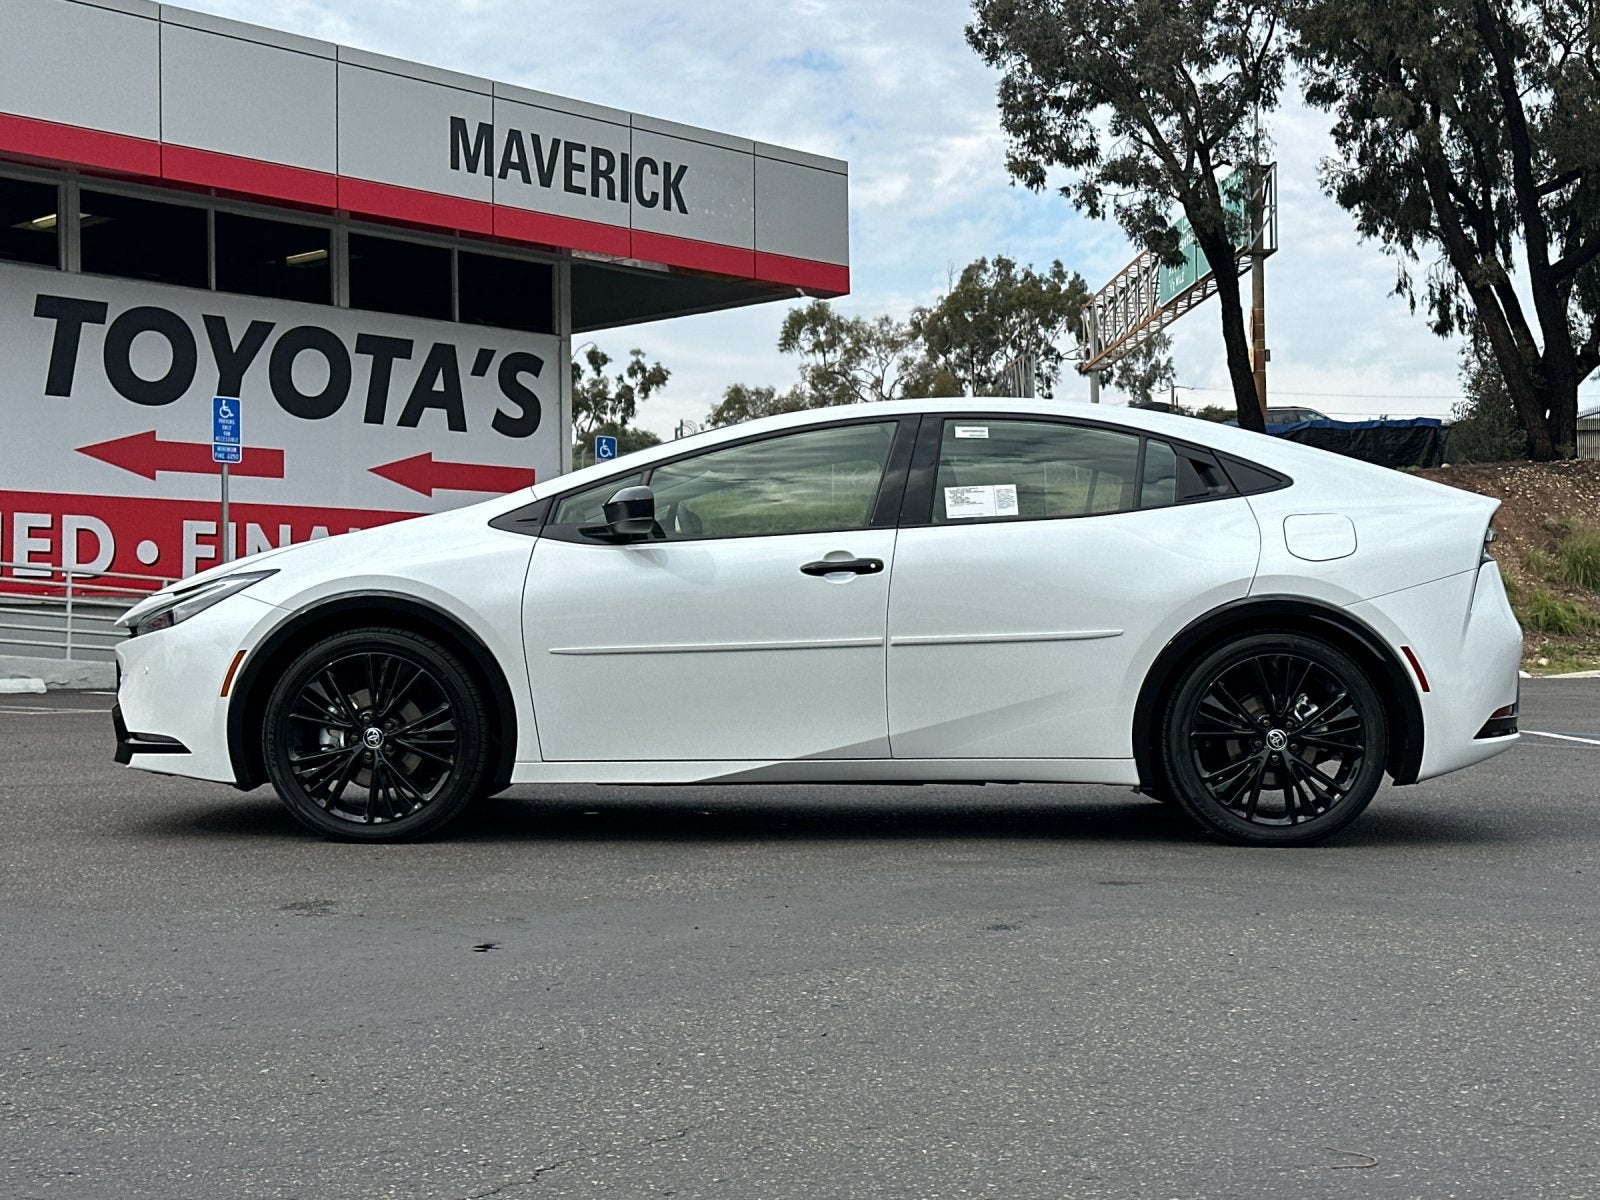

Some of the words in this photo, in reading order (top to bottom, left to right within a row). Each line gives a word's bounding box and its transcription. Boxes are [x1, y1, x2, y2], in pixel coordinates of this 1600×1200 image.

[450, 116, 688, 215] MAVERICK
[33, 293, 545, 438] TOYOTA'S
[0, 511, 115, 577] ED
